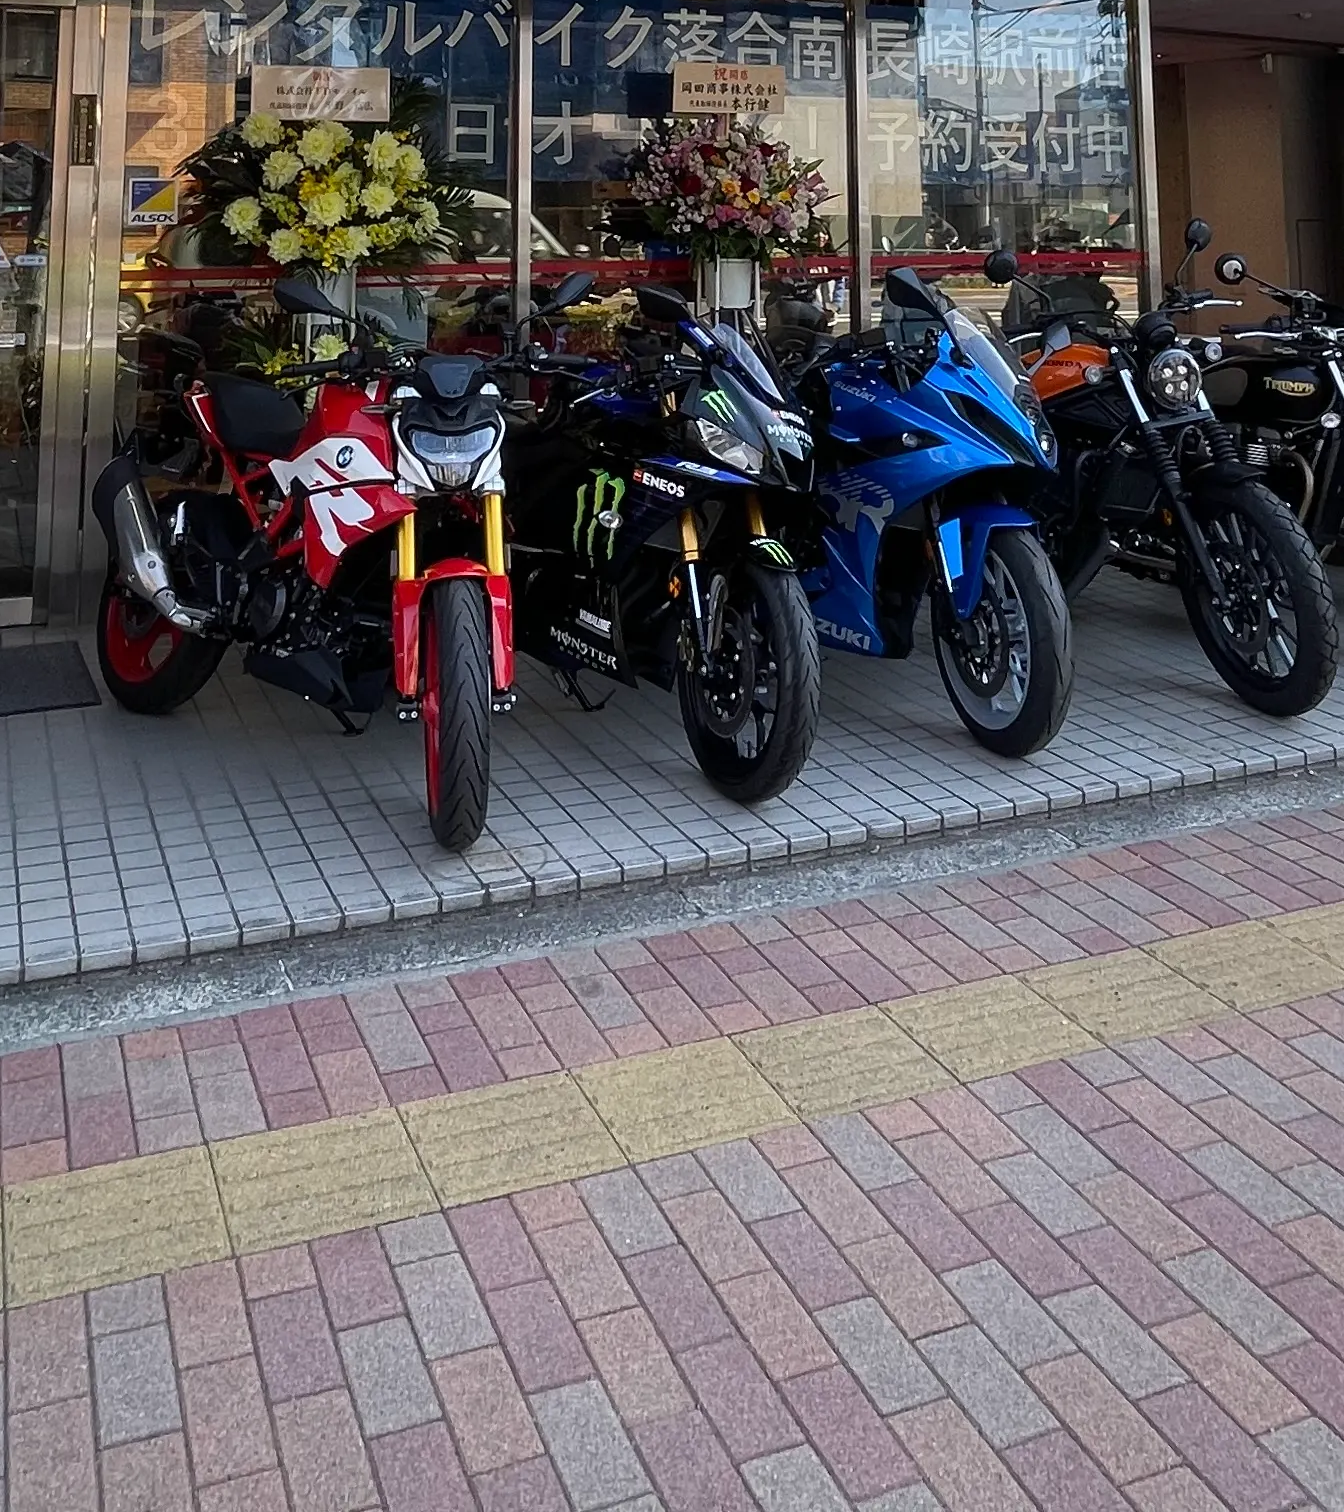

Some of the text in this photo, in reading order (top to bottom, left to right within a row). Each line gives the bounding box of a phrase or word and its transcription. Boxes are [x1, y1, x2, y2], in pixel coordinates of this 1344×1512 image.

[131, 213, 175, 223] ALSOK
[1263, 376, 1316, 395] TRIUMPH
[642, 472, 686, 499] ENEOS
[813, 613, 872, 651] ZUKI
